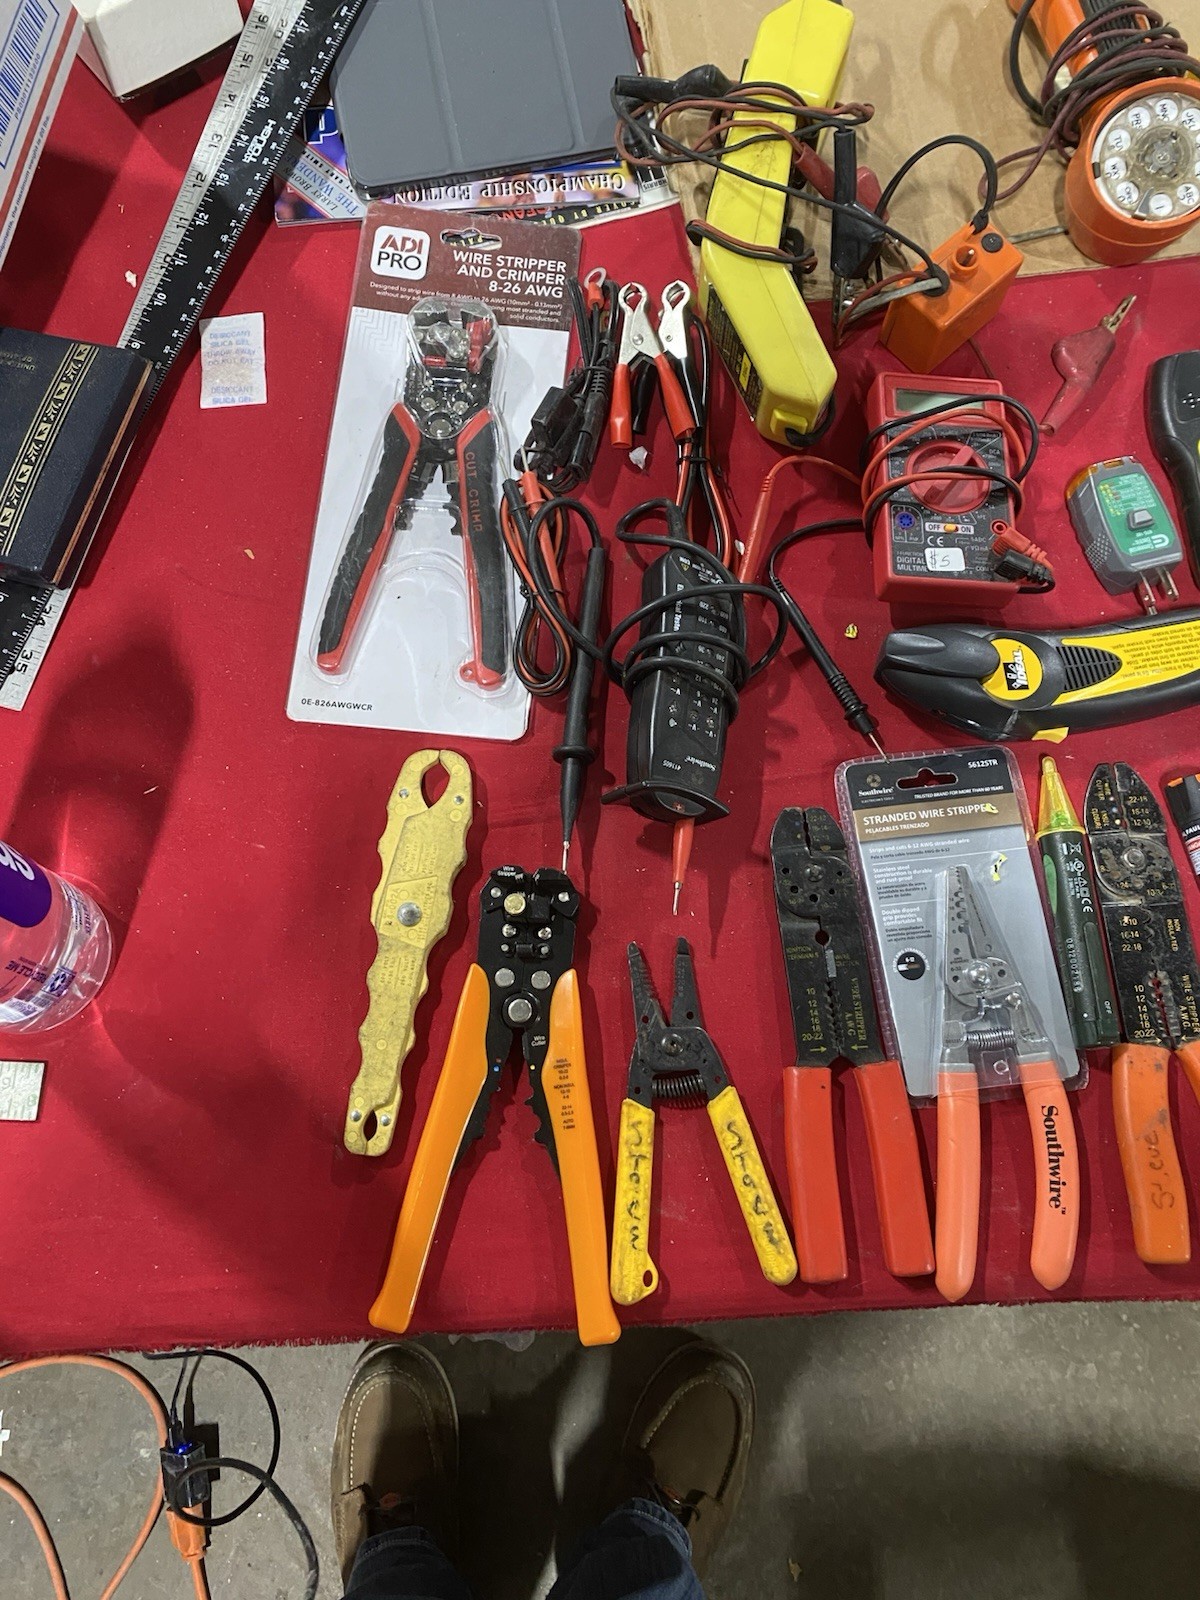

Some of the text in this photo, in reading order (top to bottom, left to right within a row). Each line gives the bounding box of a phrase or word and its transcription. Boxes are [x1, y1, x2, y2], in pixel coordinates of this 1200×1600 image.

[190, 11, 271, 190] 12 13 14 15 16
[214, 18, 311, 188] 13 14 15 16 17
[247, 117, 277, 163] TOUGH
[301, 149, 344, 184] GARY SMITH
[282, 166, 338, 210] LARRY BROWN
[393, 171, 625, 206] CHAMPIONSHIP EDITION
[334, 192, 358, 216] THE
[572, 209, 587, 218] BY
[380, 233, 424, 254] ADI
[376, 251, 422, 271] PRO
[452, 250, 567, 273] WIRE STRIPPER
[131, 210, 210, 350] 9 10 11 12
[456, 263, 566, 286] AND CRIMPER
[369, 280, 399, 291] Designed
[406, 287, 421, 295] strip
[489, 296, 506, 304] AWG
[487, 280, 564, 299] 8-26 AWG
[375, 289, 399, 297] without
[505, 305, 521, 313] most
[521, 306, 548, 316] stranded
[548, 309, 562, 317] and
[465, 451, 482, 533] CUT CRIMP
[960, 525, 972, 533] ON
[896, 555, 926, 565] DIGITAL
[12, 647, 34, 675] 35
[1012, 649, 1028, 686] IDEAL
[684, 754, 716, 771] Southwire
[967, 758, 998, 768] S612STR
[858, 786, 894, 796] Southwire
[862, 803, 987, 825] STRANDED WIRE STRIPPE
[1133, 818, 1151, 826] 12-10
[865, 821, 929, 834] PELACABLES TRENZADO
[934, 838, 957, 846] stranded
[497, 869, 516, 877] Stripper
[872, 865, 896, 873] Stainless
[873, 870, 907, 879] construction
[885, 875, 913, 883] rust-proof
[894, 912, 917, 921] provides
[901, 906, 920, 914] dipped
[883, 917, 916, 926] comfortable
[1134, 984, 1144, 992] 10
[1104, 999, 1112, 1015] OFF
[1182, 975, 1200, 1032] WIRE STRIPPER
[853, 1000, 866, 1041] STRIPPER
[531, 1039, 546, 1047] Cutter
[801, 1032, 823, 1041] 20-22
